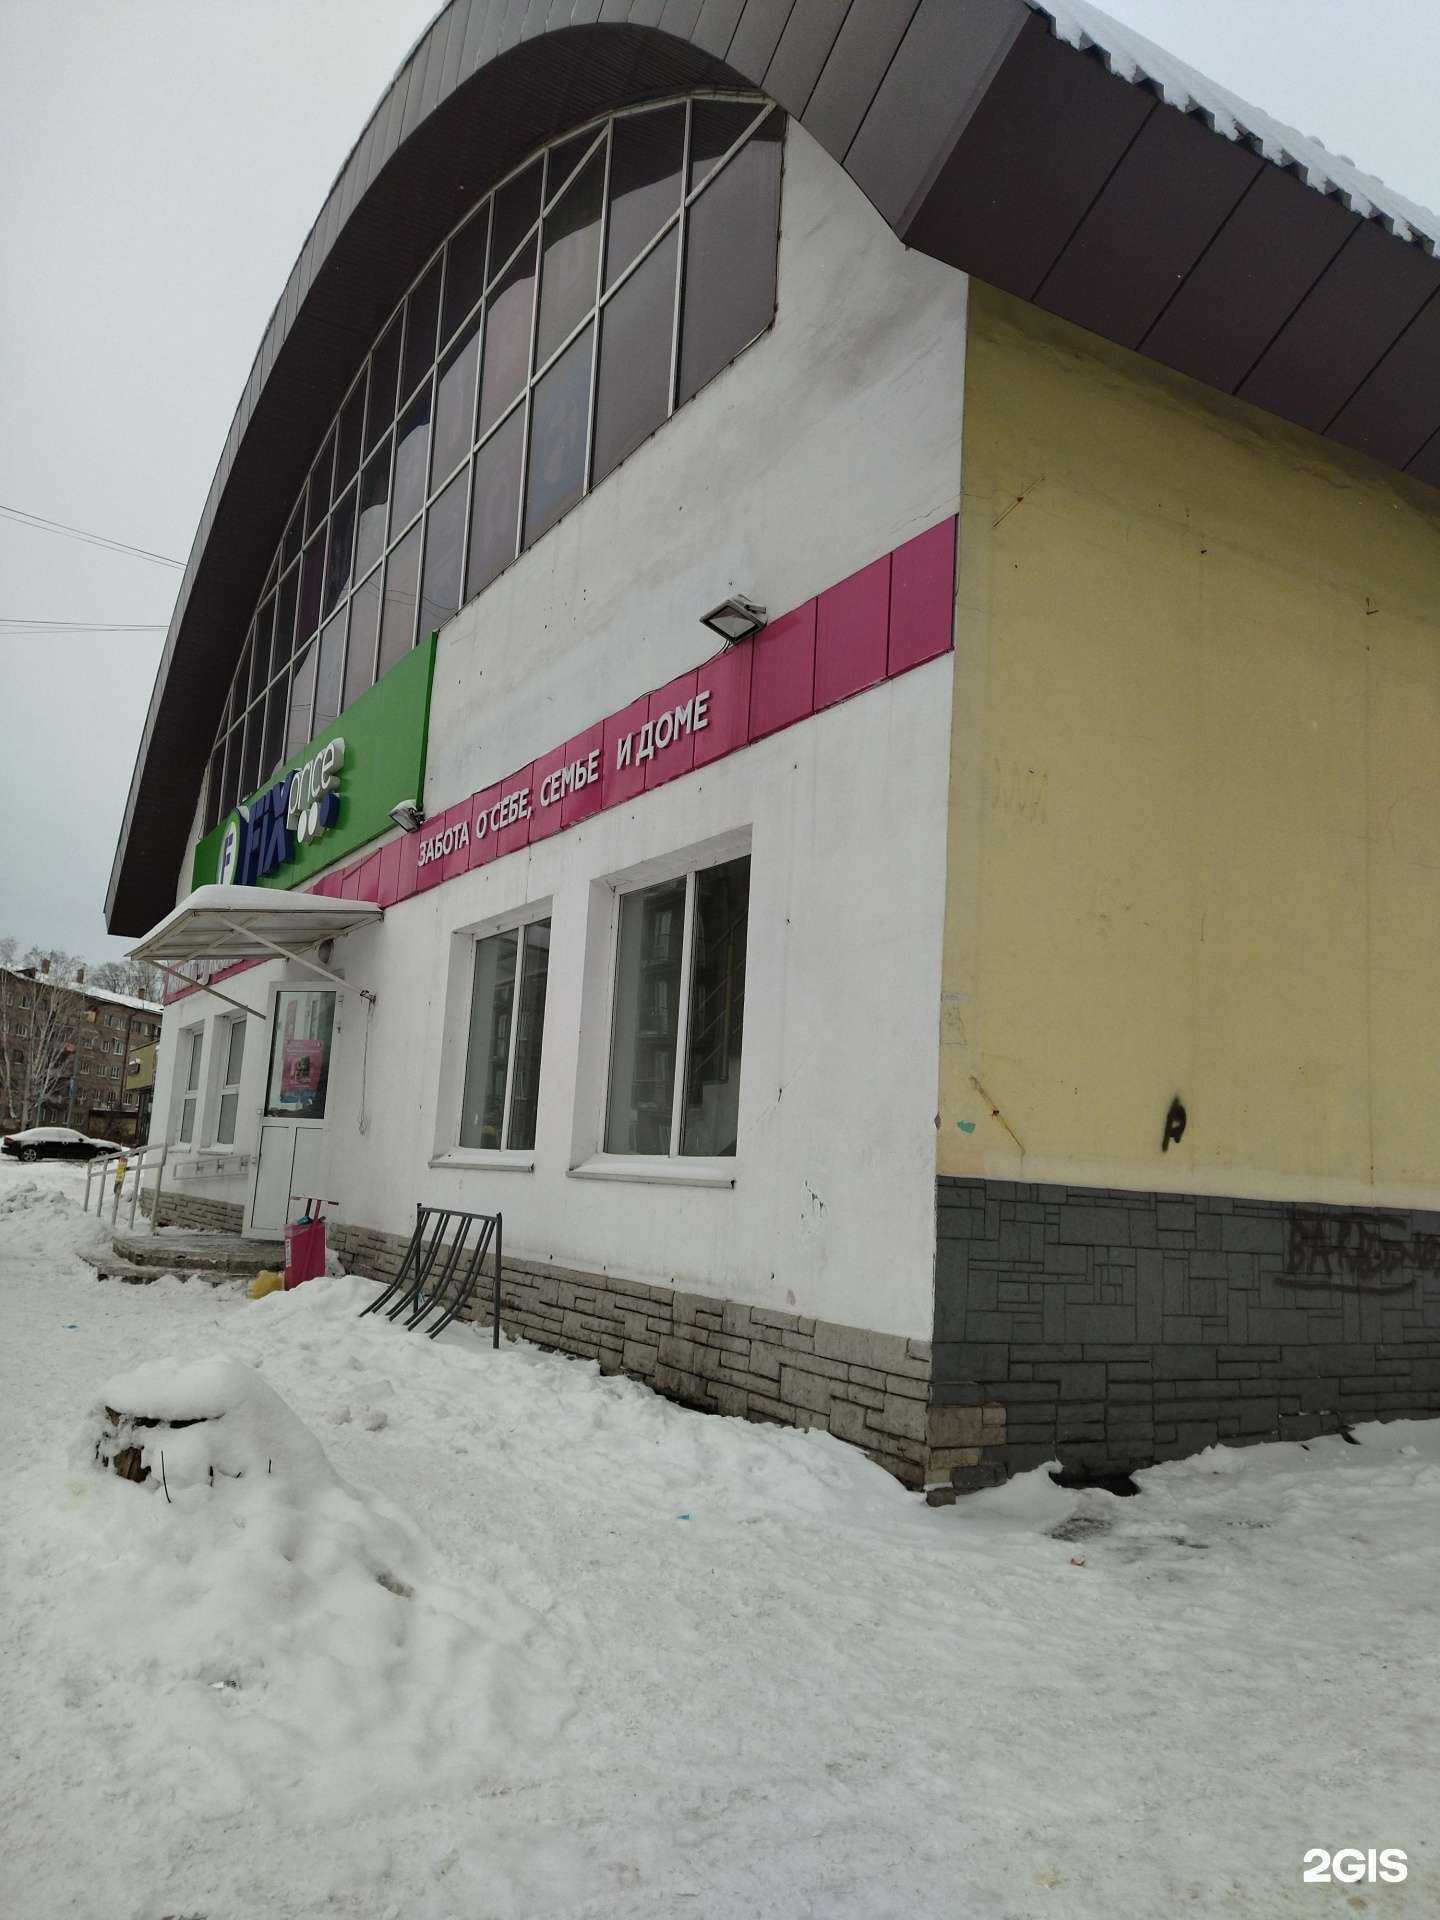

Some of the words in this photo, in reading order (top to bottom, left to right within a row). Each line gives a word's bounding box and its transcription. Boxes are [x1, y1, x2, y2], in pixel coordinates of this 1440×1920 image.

[417, 821, 469, 866] ЗАБОТА
[476, 813, 488, 839] О
[490, 787, 532, 831] СЕБЕ,
[540, 749, 600, 808] СЕМЬЕ
[616, 733, 633, 770] И
[636, 690, 711, 767] ДОМЕ
